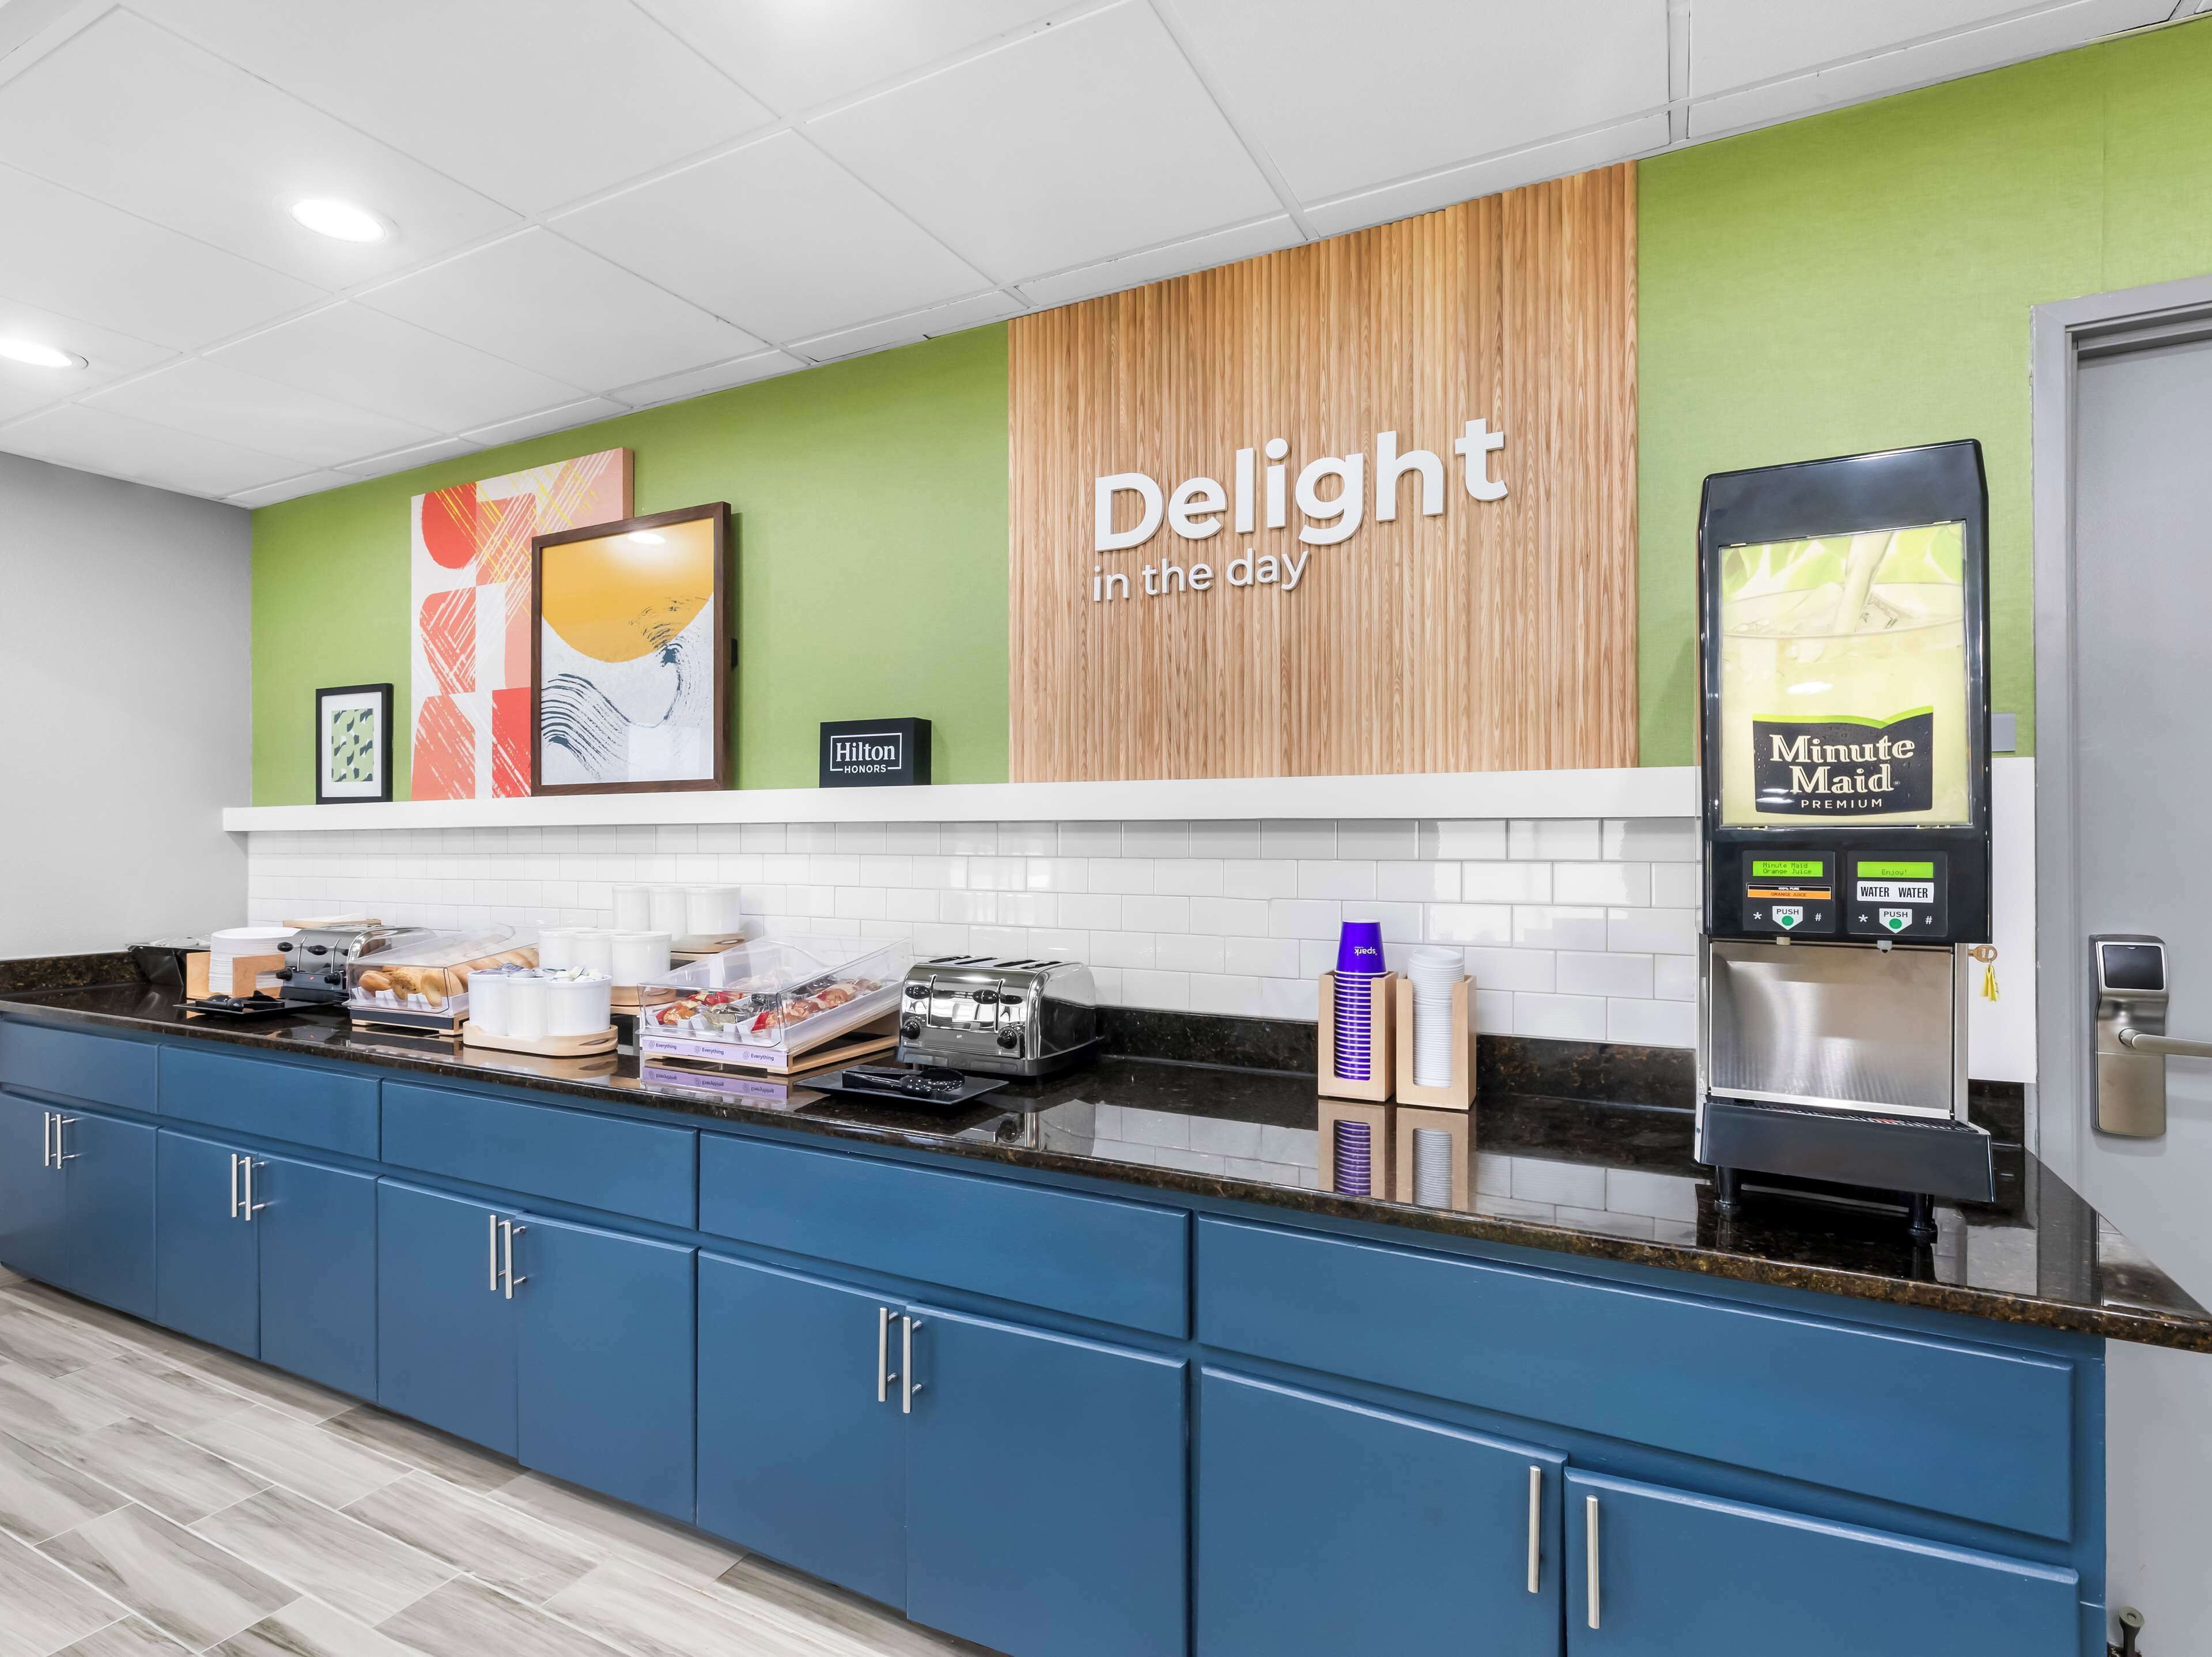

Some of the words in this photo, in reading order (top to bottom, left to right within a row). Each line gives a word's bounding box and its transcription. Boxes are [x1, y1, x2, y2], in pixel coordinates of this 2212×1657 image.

[1095, 418, 1509, 553] Delight
[1094, 566, 1130, 602] in
[1142, 558, 1214, 596] the
[1227, 548, 1309, 591] day
[835, 742, 896, 762] Hilton
[1769, 734, 1915, 763] Minute
[844, 764, 886, 773] HONORS
[1789, 764, 1895, 794] Maid
[1801, 798, 1882, 809] PREMIUM
[1861, 886, 1889, 897] WATER
[1899, 888, 1928, 898] WATER
[1354, 946, 1376, 956] spark
[702, 1047, 724, 1055] Everything
